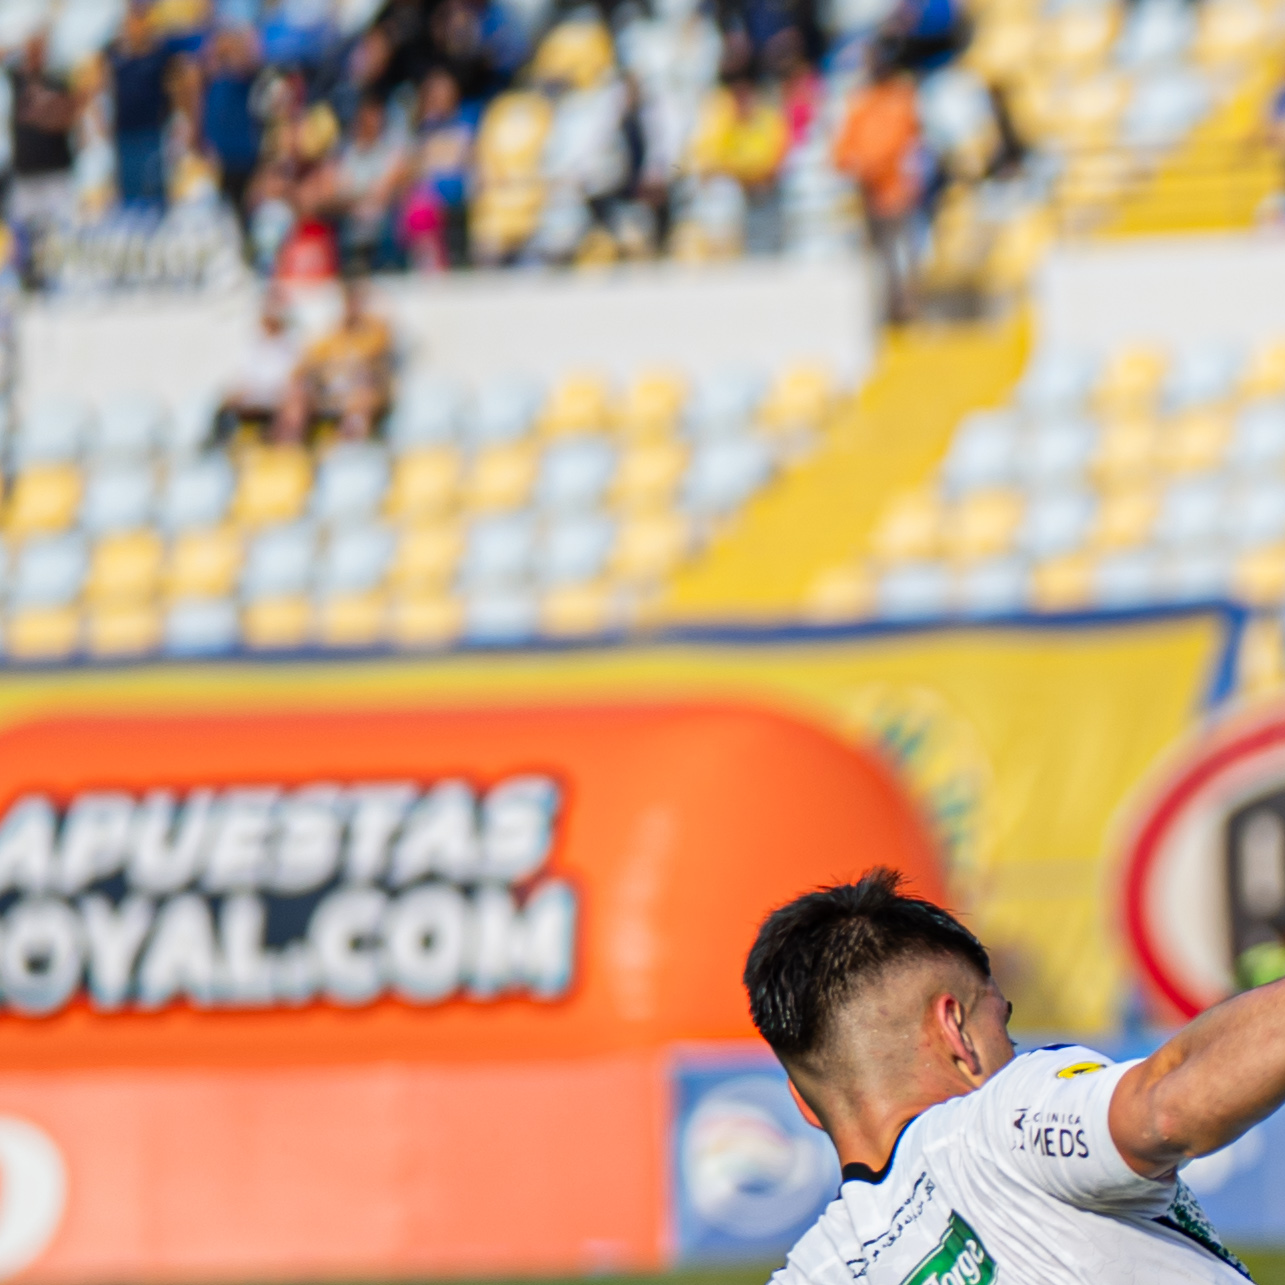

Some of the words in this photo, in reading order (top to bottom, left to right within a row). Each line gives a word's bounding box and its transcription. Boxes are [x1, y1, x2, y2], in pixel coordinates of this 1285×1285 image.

[0, 773, 562, 896] APUESTAS
[0, 878, 578, 1016] OYAL.COM
[1029, 1126, 1089, 1158] MEDS
